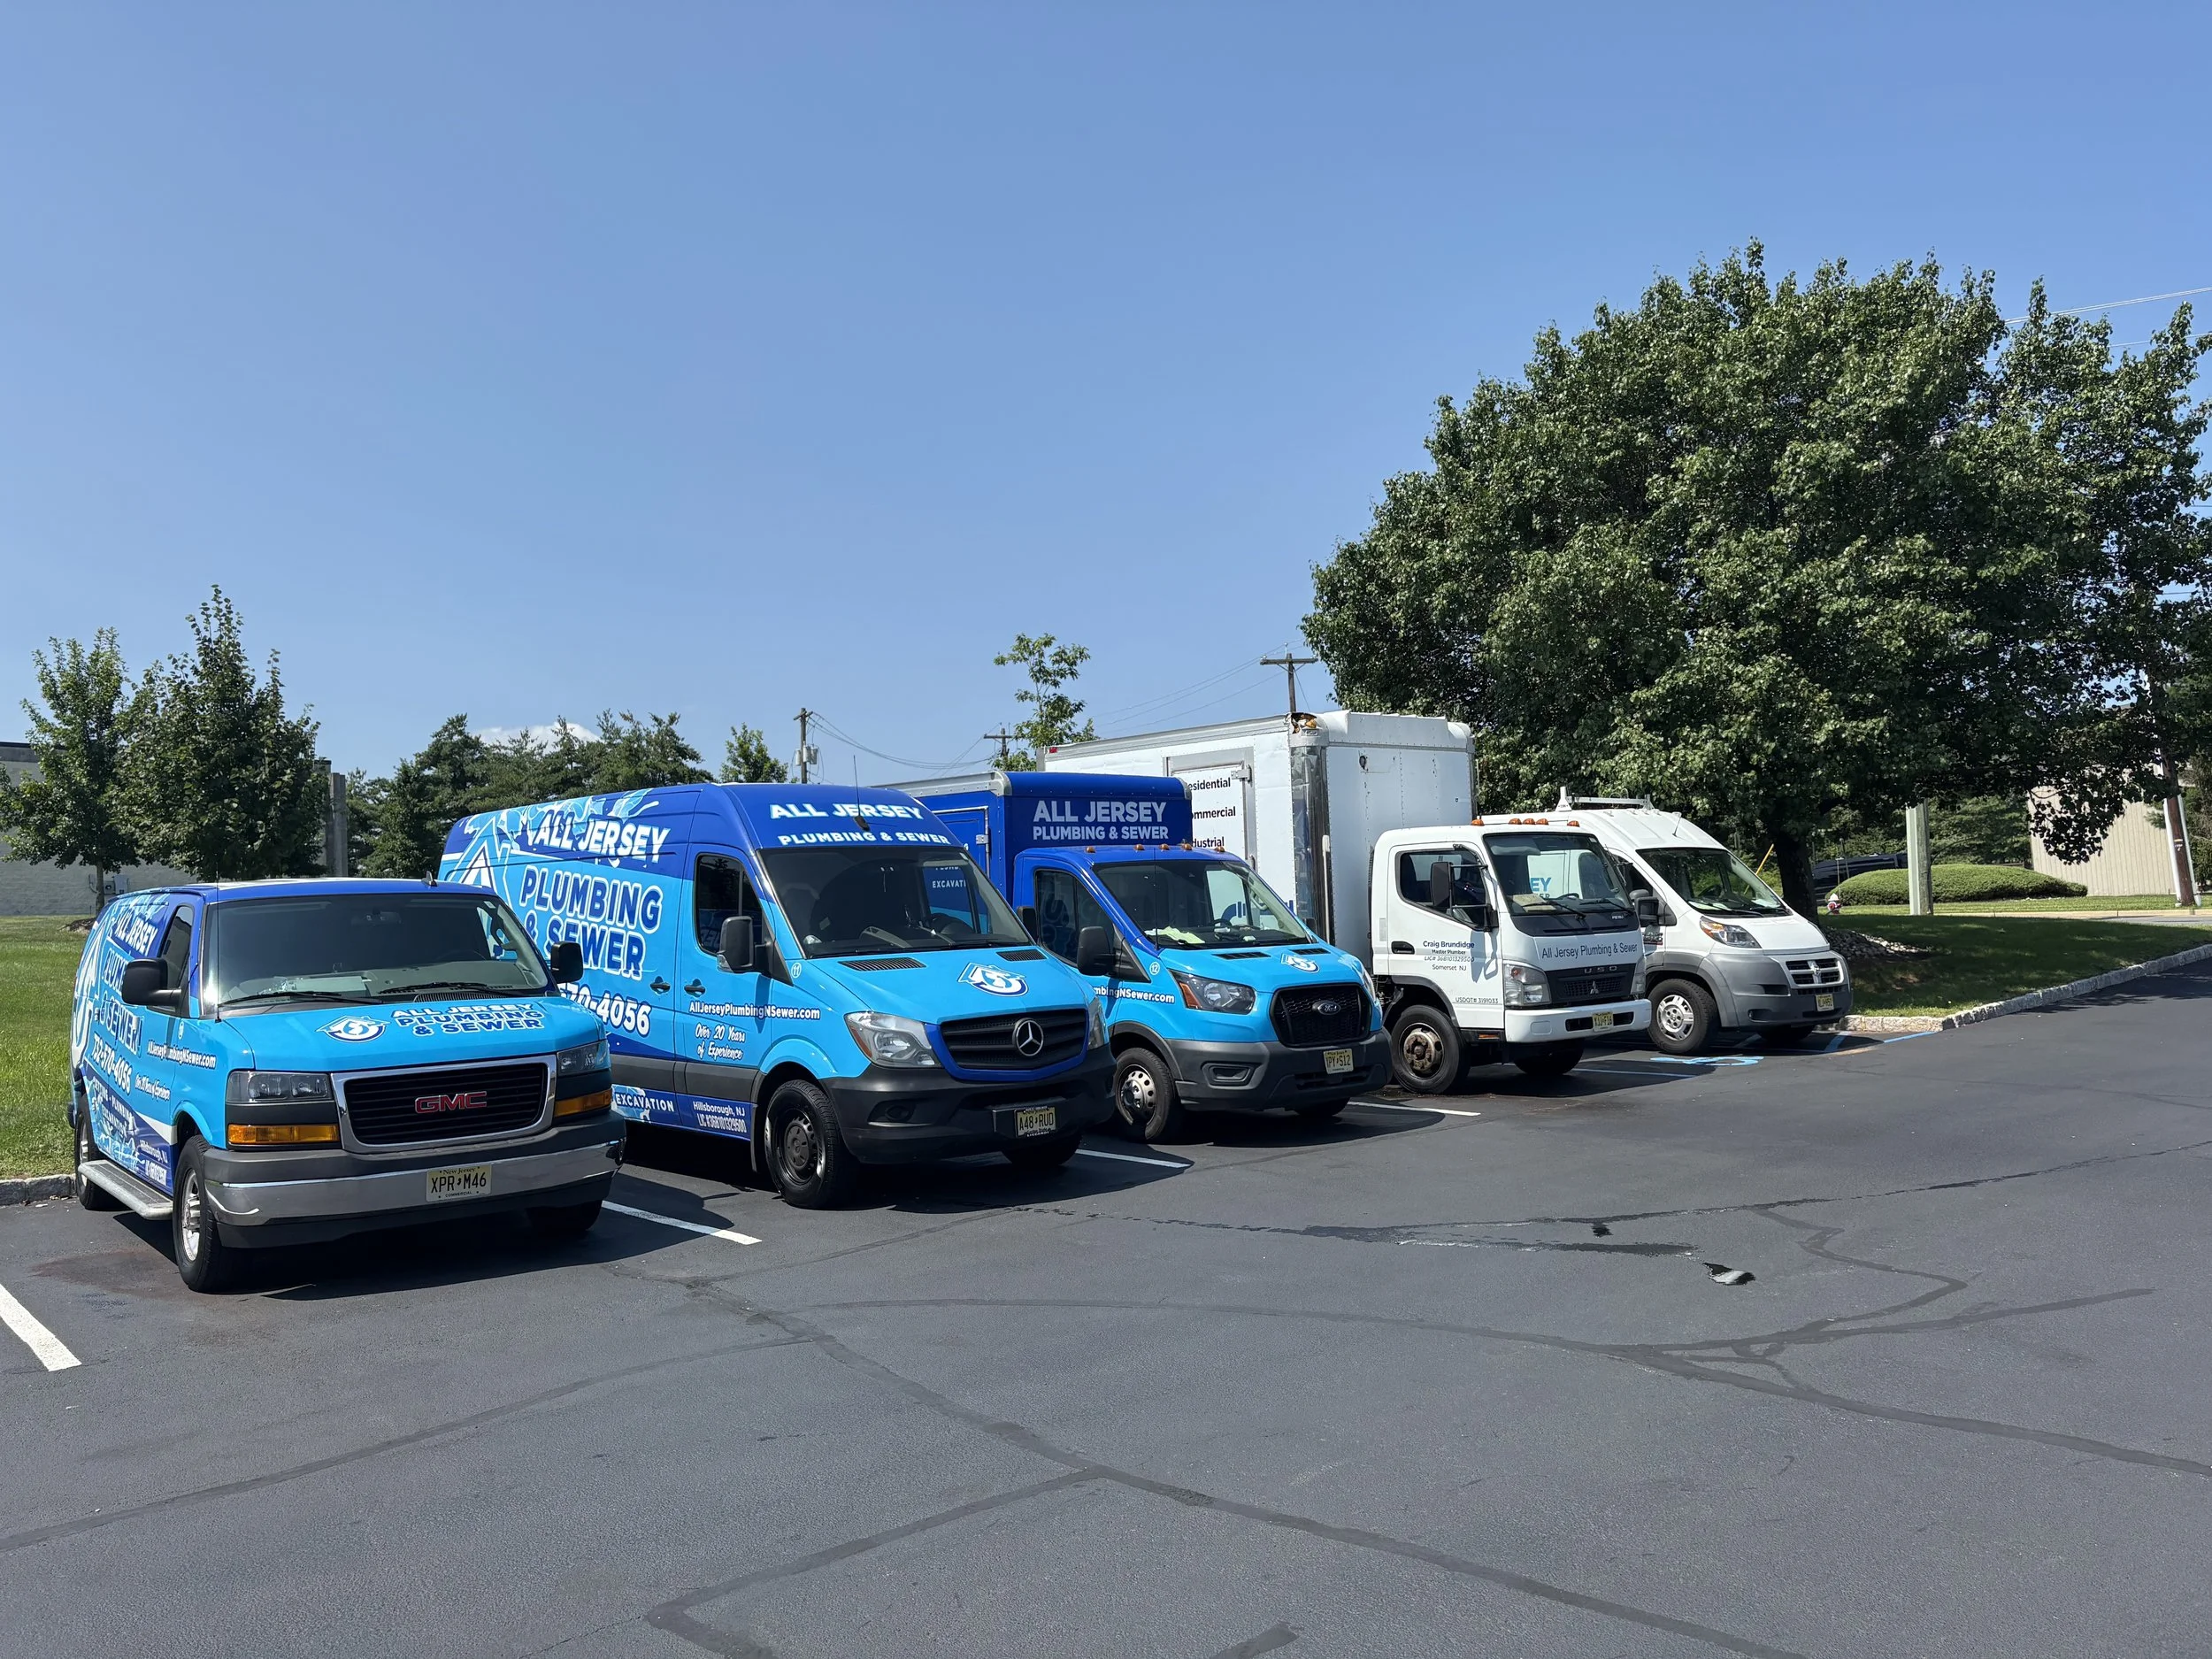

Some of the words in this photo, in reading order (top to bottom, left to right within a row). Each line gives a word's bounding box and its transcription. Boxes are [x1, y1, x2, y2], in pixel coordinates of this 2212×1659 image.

[1187, 777, 1231, 790] esidential
[770, 803, 829, 819] ALL
[832, 803, 924, 820] JERSEY
[1033, 800, 1079, 823] ALL
[1084, 801, 1167, 823] JERSEY
[1192, 806, 1236, 819] mmercial
[534, 810, 574, 850] ALL
[578, 818, 671, 864] JERSEY
[777, 832, 879, 846] PLUMBING
[880, 832, 894, 841] &
[897, 832, 951, 845] SEWER
[1033, 826, 1105, 840] PLUMBING
[1109, 826, 1118, 840] &
[1121, 826, 1169, 840] SEWER
[1193, 836, 1225, 848] dustrial
[932, 879, 966, 888] EXCAVATI
[519, 864, 664, 933] PLUMBING
[114, 910, 134, 941] ALL
[125, 917, 158, 956] JERSEY
[525, 910, 538, 942] &
[1542, 948, 1553, 959] All
[1555, 947, 1578, 959] Jersey
[1580, 943, 1611, 956] Plumbing
[1613, 943, 1618, 954] &
[1619, 942, 1638, 953] Sewer
[1151, 964, 1158, 973] 12
[1094, 986, 1175, 1003] mbingNSewer.com
[391, 1008, 442, 1018] ALL
[446, 1003, 534, 1014] JERSEY
[396, 1010, 544, 1026] PLUMBING
[557, 982, 652, 1037] 570-4056
[688, 1001, 821, 1020] AllJerseyPlumbingNSewer.com
[106, 996, 140, 1055] SEWER
[413, 1025, 435, 1036] &
[442, 1018, 545, 1033] SEWER
[695, 1023, 711, 1039] Over
[713, 1024, 726, 1040] 20
[728, 1025, 746, 1043] Years
[697, 1041, 705, 1058] of
[708, 1041, 743, 1060] Experience
[414, 1090, 487, 1113] GMC
[615, 1094, 674, 1112] EXCAVATION
[693, 1101, 736, 1115] Hillsborough,
[736, 1107, 745, 1117] NJ
[1019, 1115, 1033, 1131] A48
[1039, 1112, 1054, 1127] RUD
[431, 1175, 455, 1194] XPR
[464, 1172, 487, 1189] M46
